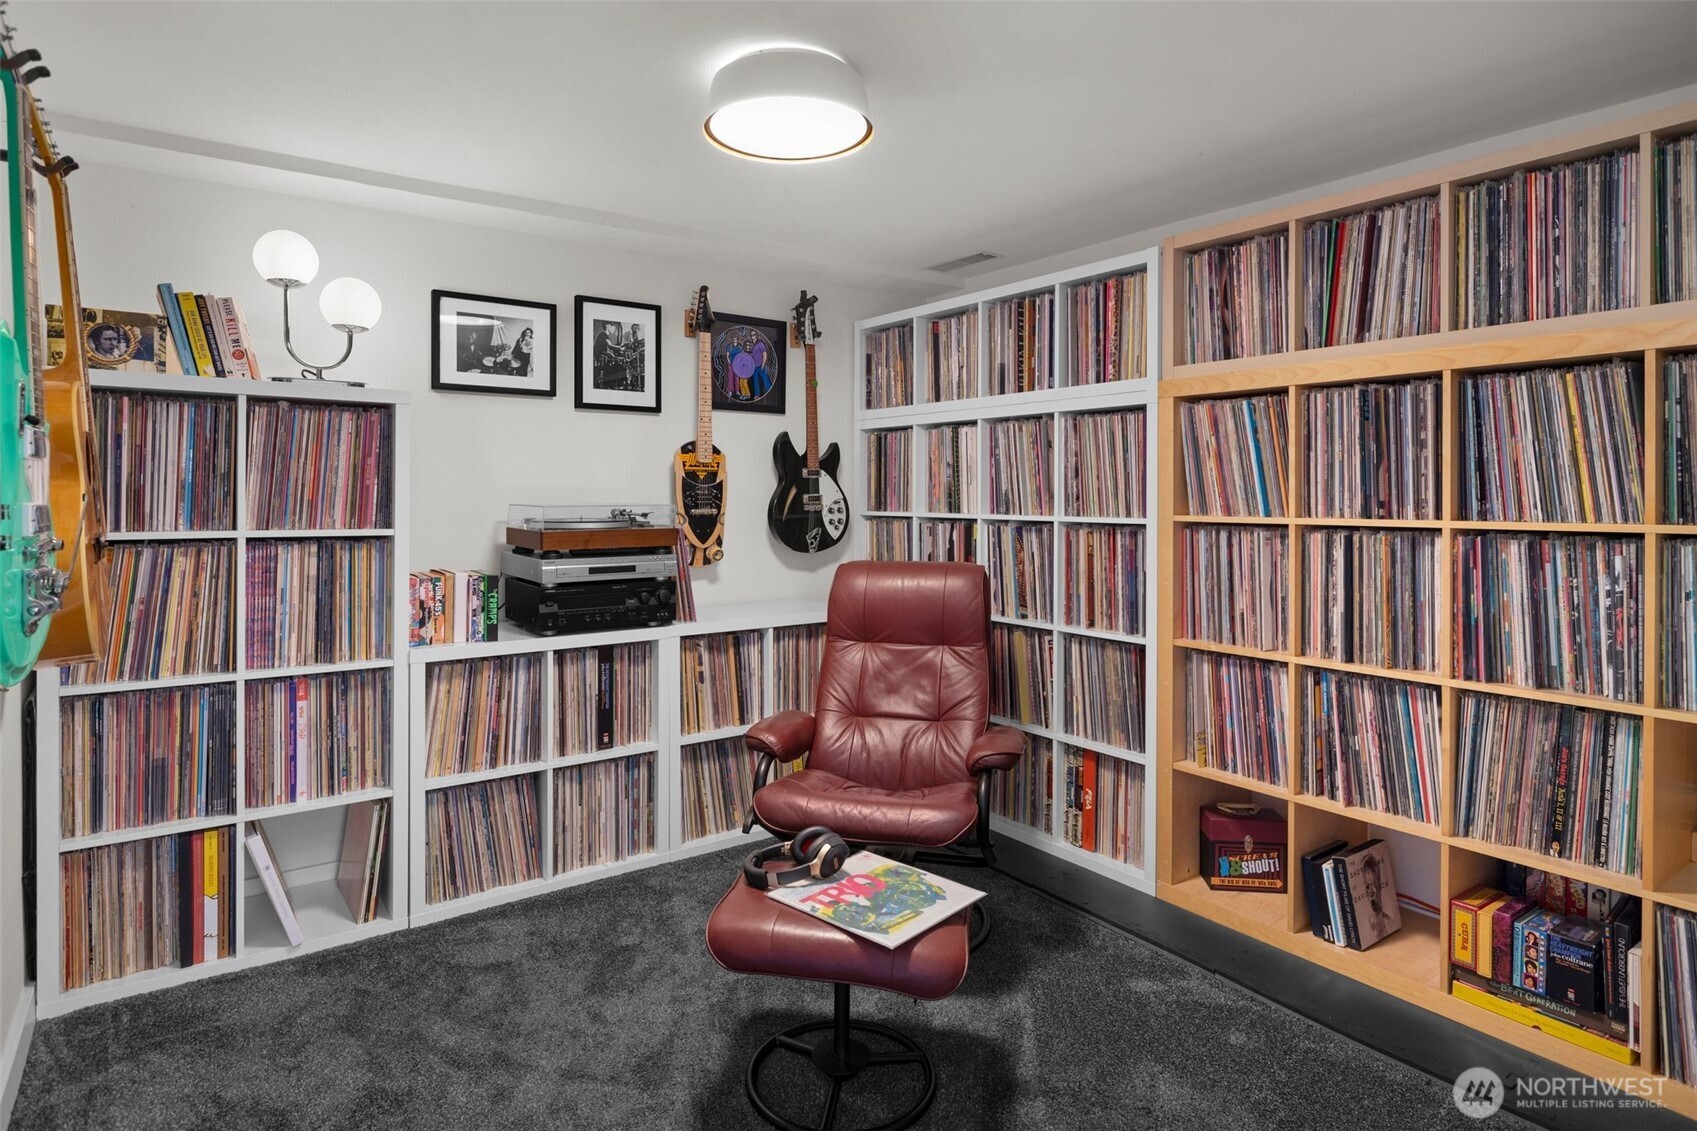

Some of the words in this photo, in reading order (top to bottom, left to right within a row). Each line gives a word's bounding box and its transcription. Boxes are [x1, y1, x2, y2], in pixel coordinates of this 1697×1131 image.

[222, 298, 233, 316] PLEASE
[231, 339, 241, 349] ME
[435, 582, 443, 598] FUNK
[487, 593, 497, 625] CRAMPS
[1084, 788, 1093, 810] FELA
[1242, 858, 1280, 875] SHOUT!
[799, 873, 888, 909] TRIO
[1339, 872, 1347, 890] SHORT
[1346, 912, 1354, 927] DAVID
[1461, 922, 1469, 952] CUBA
[1550, 940, 1594, 957] HEAVYWEIGHT
[1561, 954, 1594, 969] coltrane
